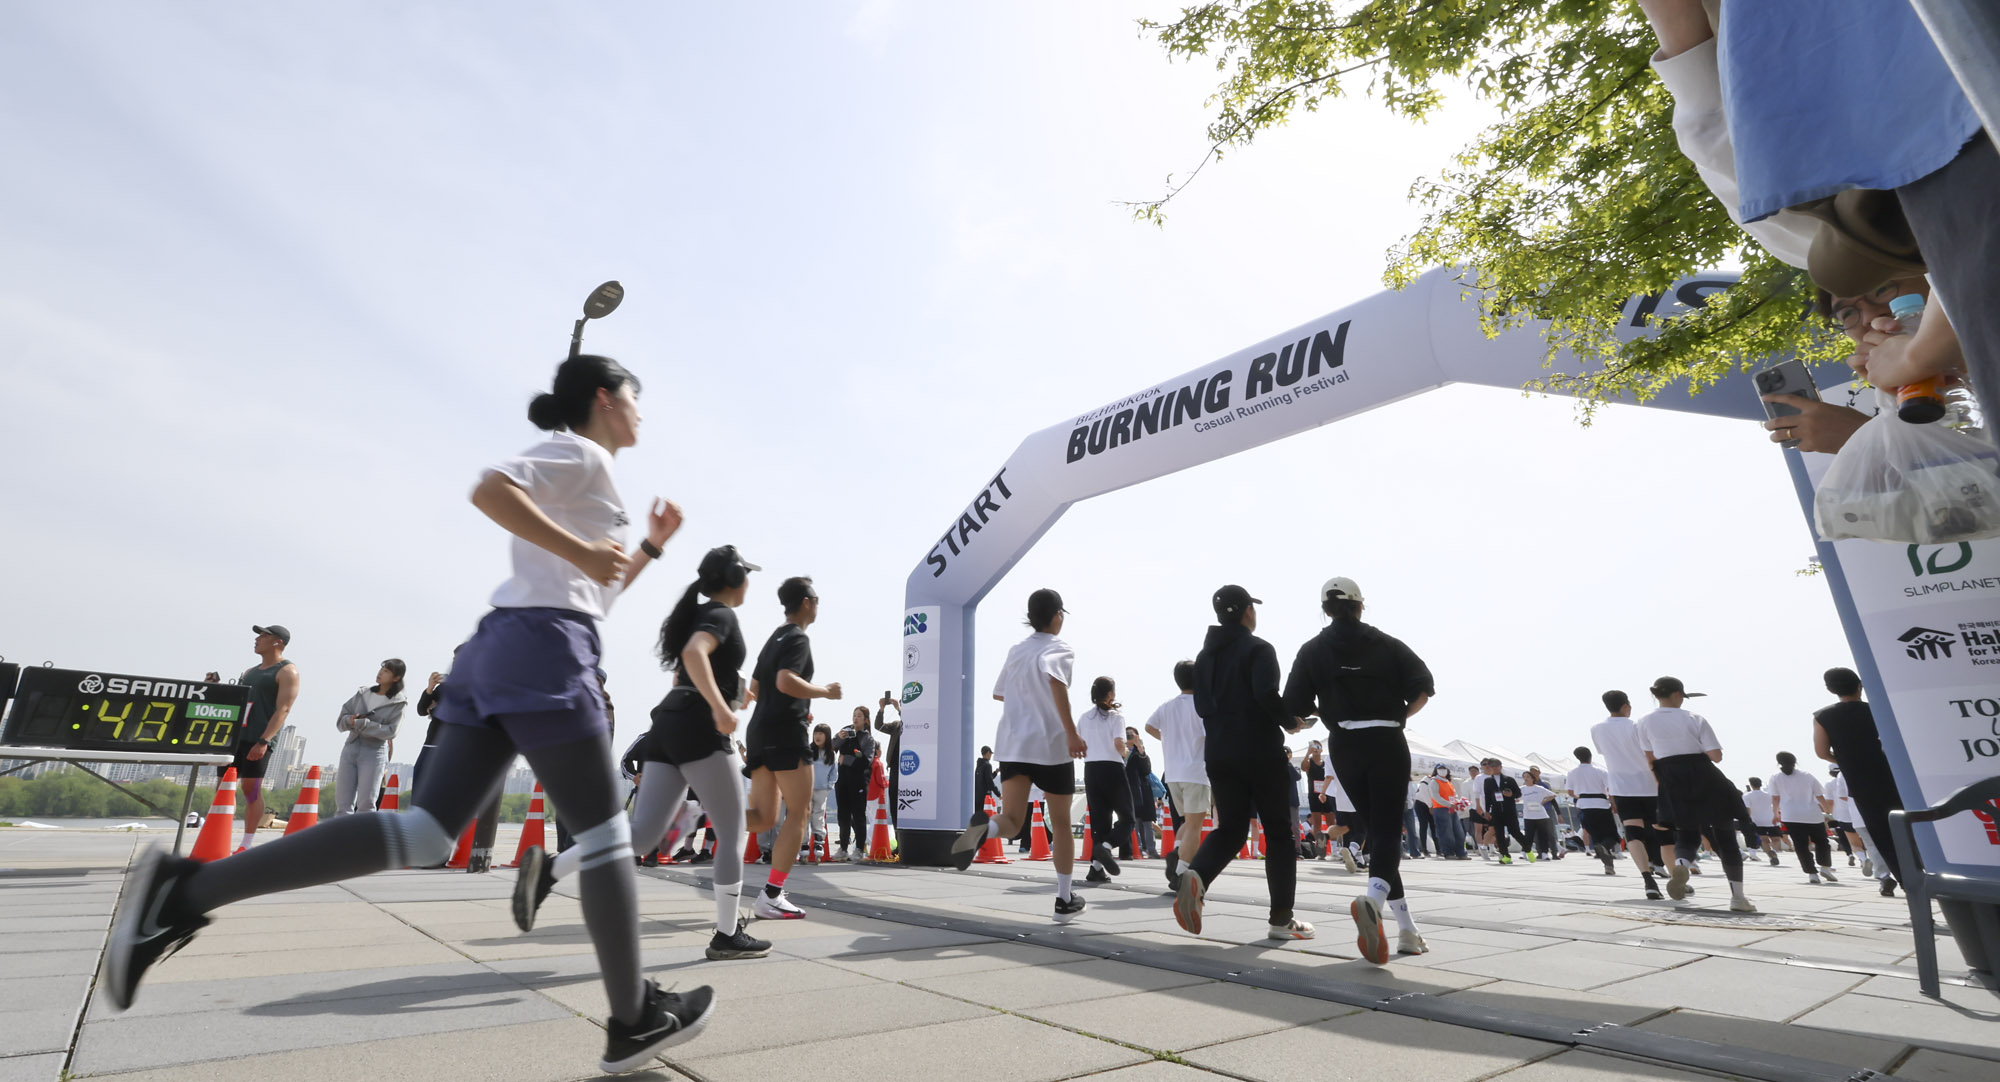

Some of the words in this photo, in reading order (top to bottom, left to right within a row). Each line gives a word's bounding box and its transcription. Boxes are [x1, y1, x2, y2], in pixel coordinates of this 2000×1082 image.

[1067, 369, 1233, 464] BURNING
[1245, 319, 1352, 401] RUN
[1194, 411, 1235, 433] Casual
[1236, 393, 1293, 418] Running
[1293, 369, 1350, 398] Festival
[926, 467, 1012, 578] START
[1904, 577, 2000, 597] SLIMPLANET
[1968, 647, 1987, 656] for
[106, 677, 208, 701] SAMIK
[194, 704, 232, 719] 10km
